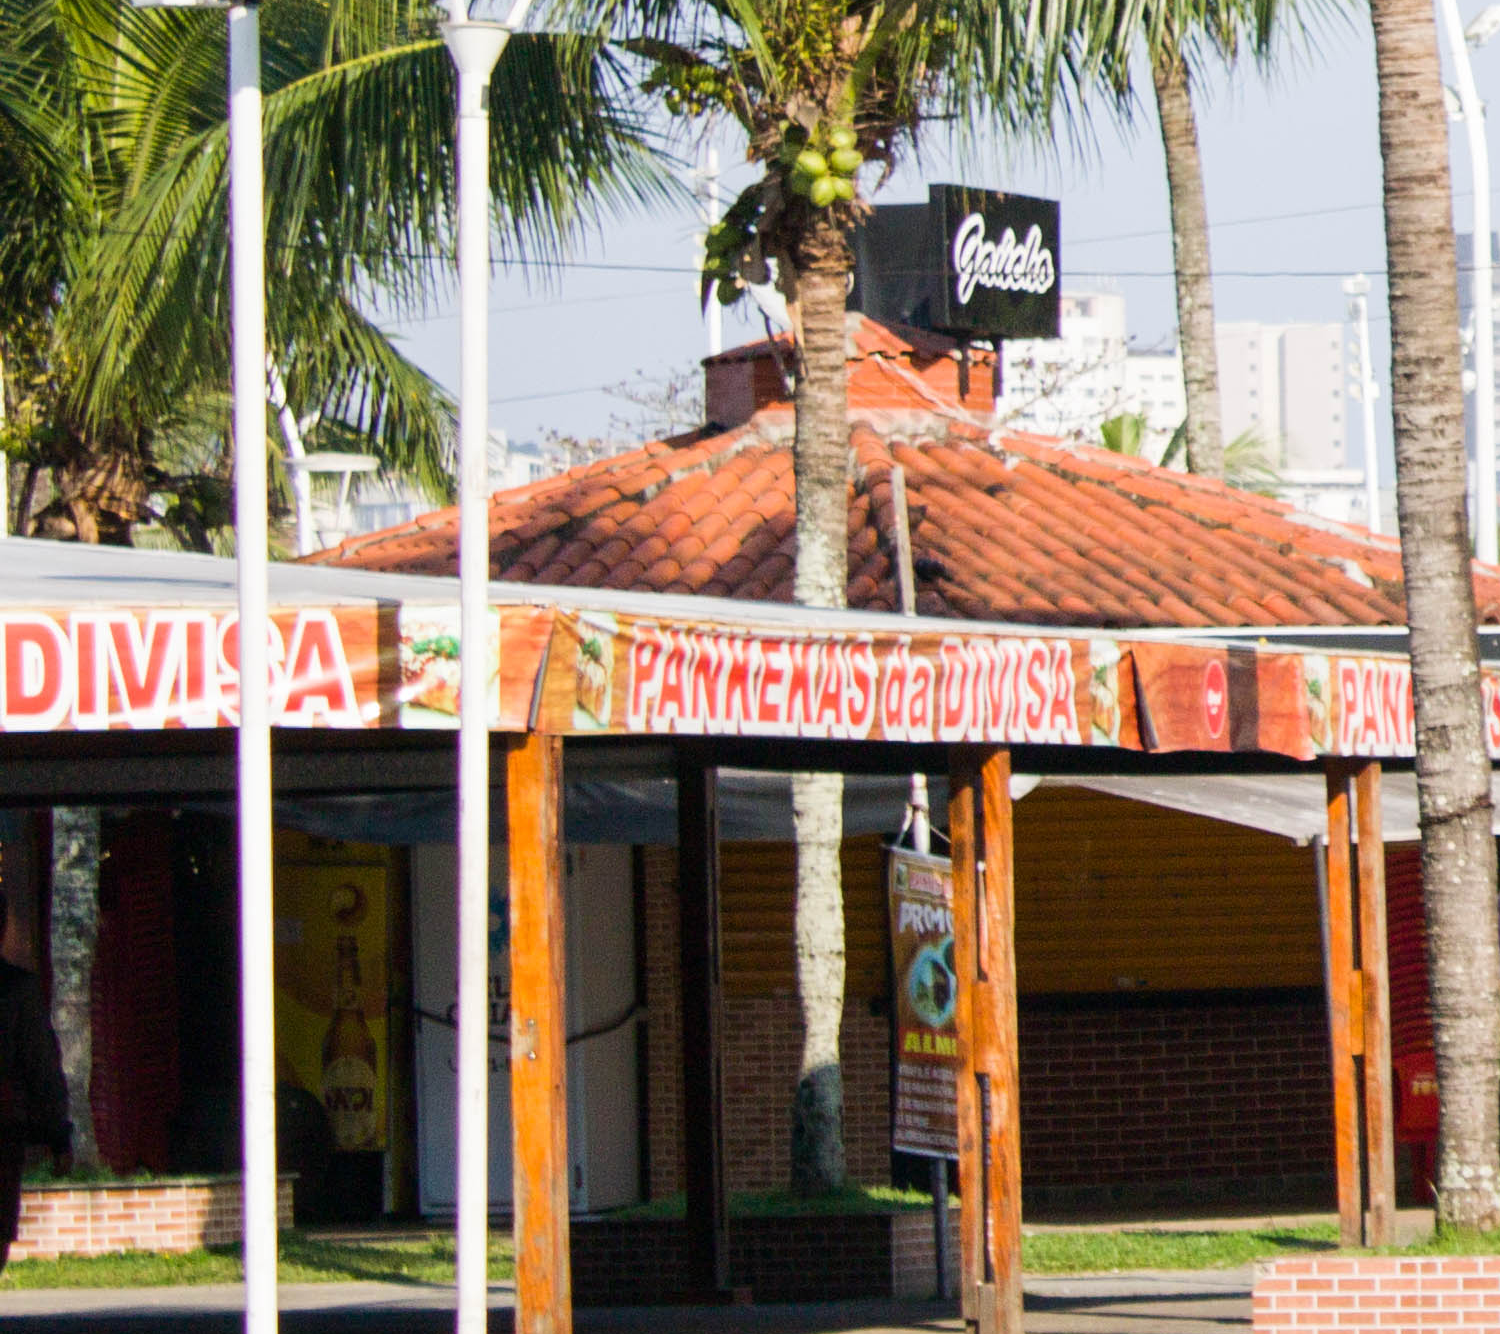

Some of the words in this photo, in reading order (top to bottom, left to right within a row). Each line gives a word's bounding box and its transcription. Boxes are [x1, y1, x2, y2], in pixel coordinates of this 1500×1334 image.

[883, 636, 933, 739] da
[939, 639, 1079, 742] DIVISA
[904, 1032, 957, 1057] ALM
